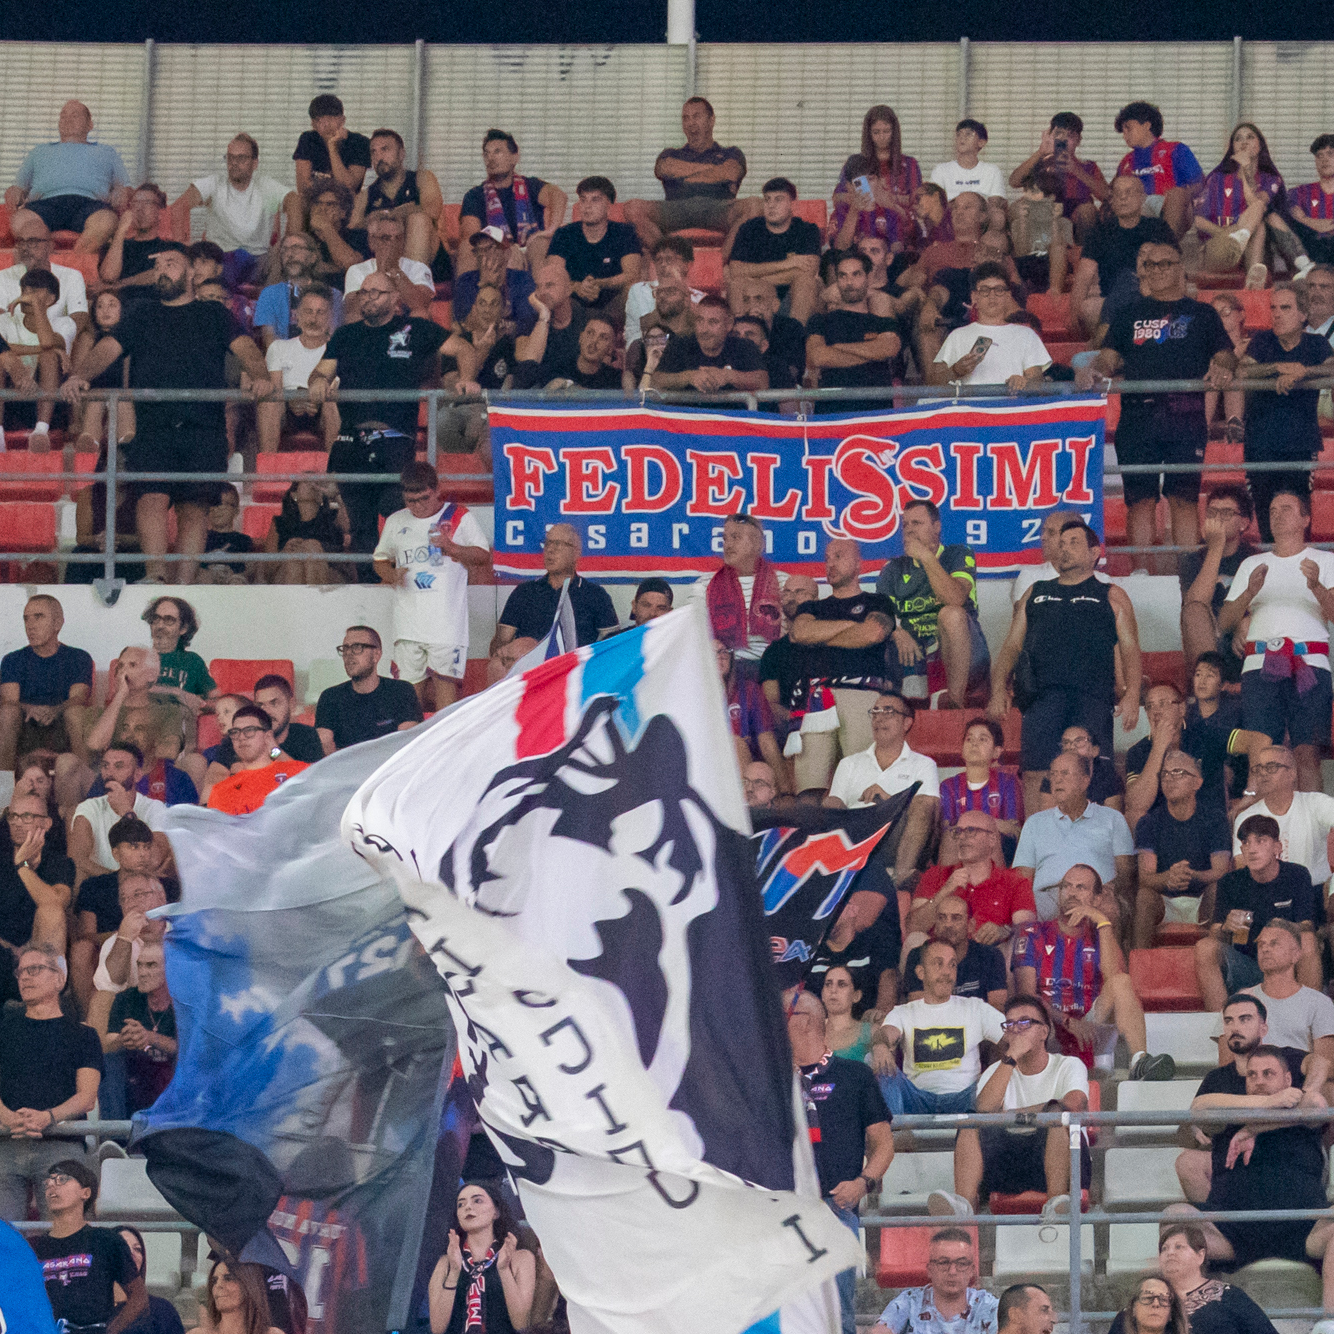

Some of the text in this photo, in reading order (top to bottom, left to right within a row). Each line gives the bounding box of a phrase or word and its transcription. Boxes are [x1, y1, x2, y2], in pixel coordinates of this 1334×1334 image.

[1133, 319, 1169, 331] CUSP
[1133, 328, 1161, 340] 1980
[503, 434, 1096, 543] FEDELISSIMI
[504, 518, 818, 555] csarano
[43, 1256, 91, 1269] ASARANO
